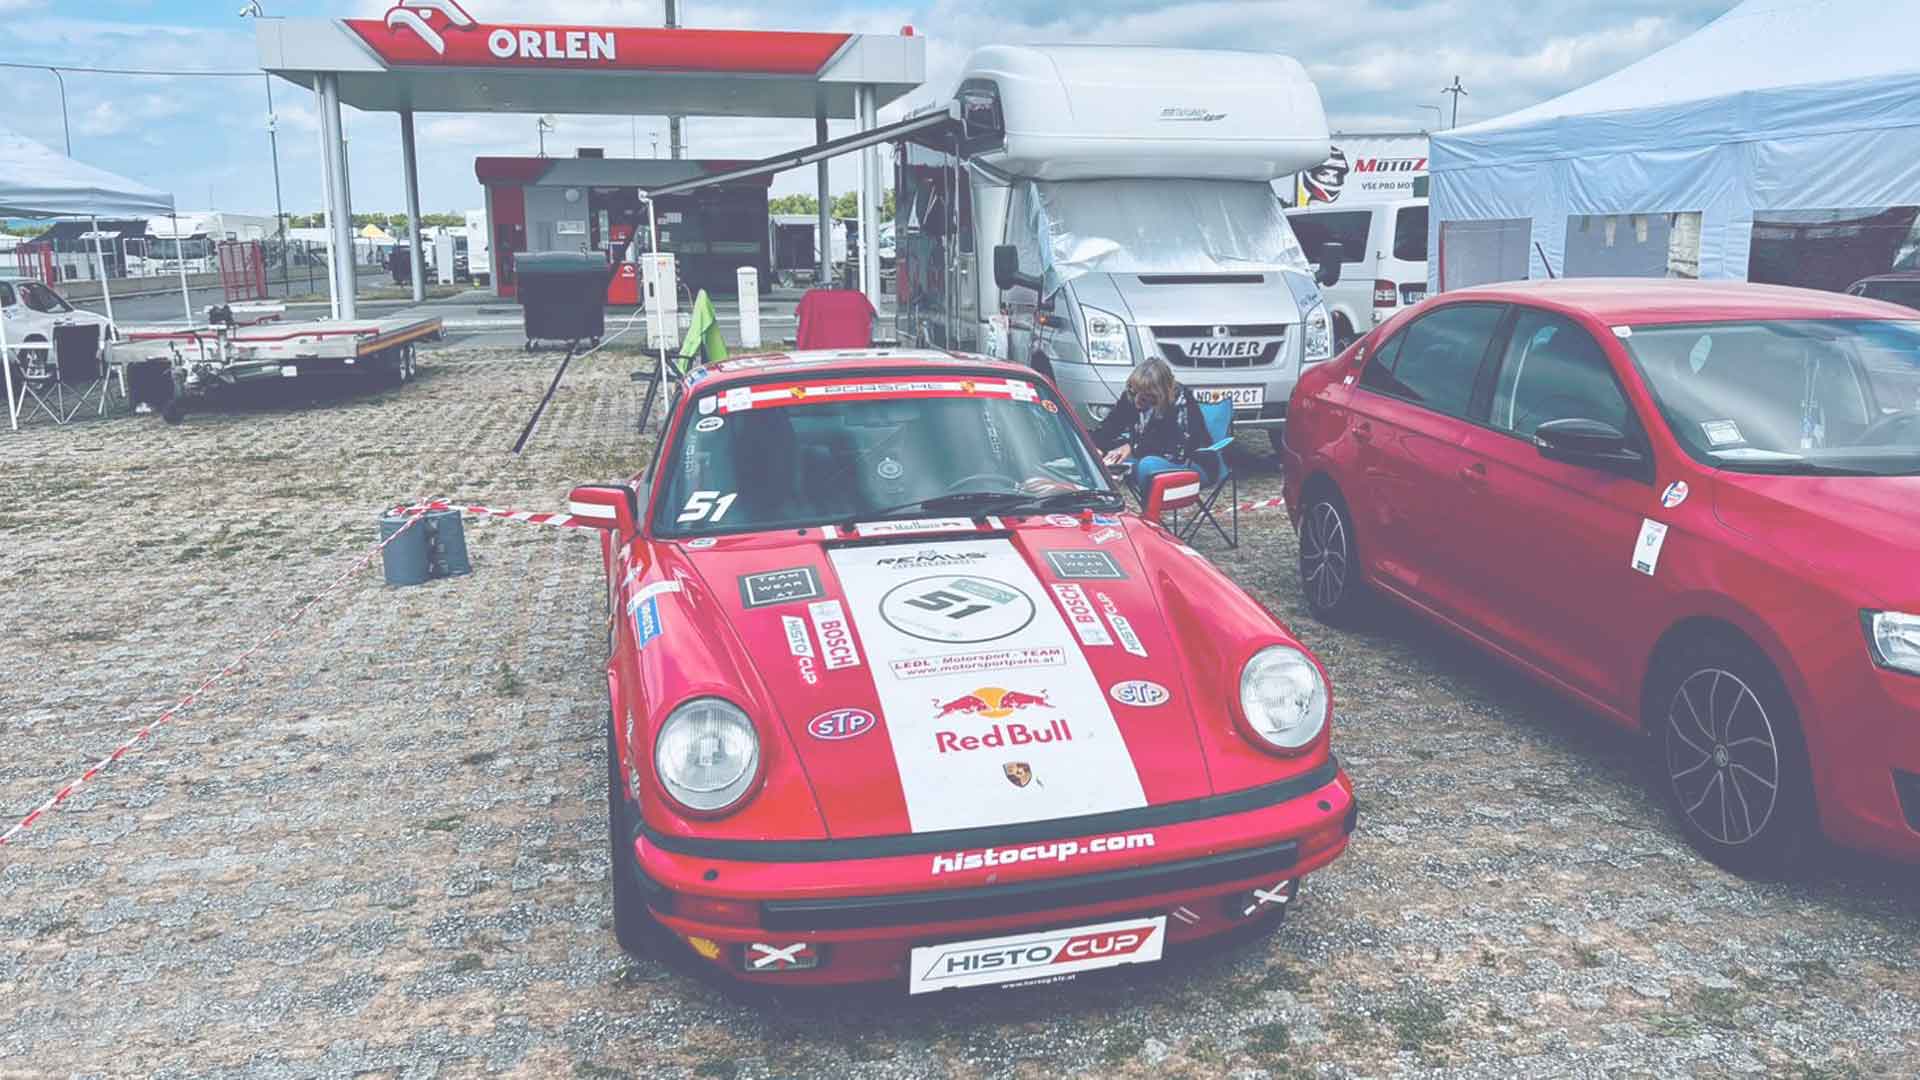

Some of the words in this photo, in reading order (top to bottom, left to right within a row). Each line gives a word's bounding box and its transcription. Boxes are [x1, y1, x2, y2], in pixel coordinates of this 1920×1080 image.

[488, 28, 616, 60] ORLEN
[1189, 341, 1261, 357] HYMER
[677, 490, 738, 523] 51
[758, 581, 802, 591] WEAR
[759, 573, 799, 582] TEAM
[902, 590, 992, 619] 51
[1056, 584, 1096, 624] BOSCH
[821, 619, 855, 667] BOSCH
[1112, 616, 1141, 651] HISTO
[787, 619, 809, 654] HISTO
[798, 656, 817, 685] CUP
[894, 659, 931, 670] LEDL
[942, 652, 1010, 665] Motorsport
[1023, 649, 1060, 657] TEAM
[1120, 682, 1163, 702] STP
[819, 712, 866, 734] STP
[936, 724, 1005, 753] Red
[1006, 719, 1073, 746] Bull
[931, 831, 1155, 875] histocup.com
[946, 945, 1053, 973] HISTO
[1066, 933, 1139, 957] CUP
